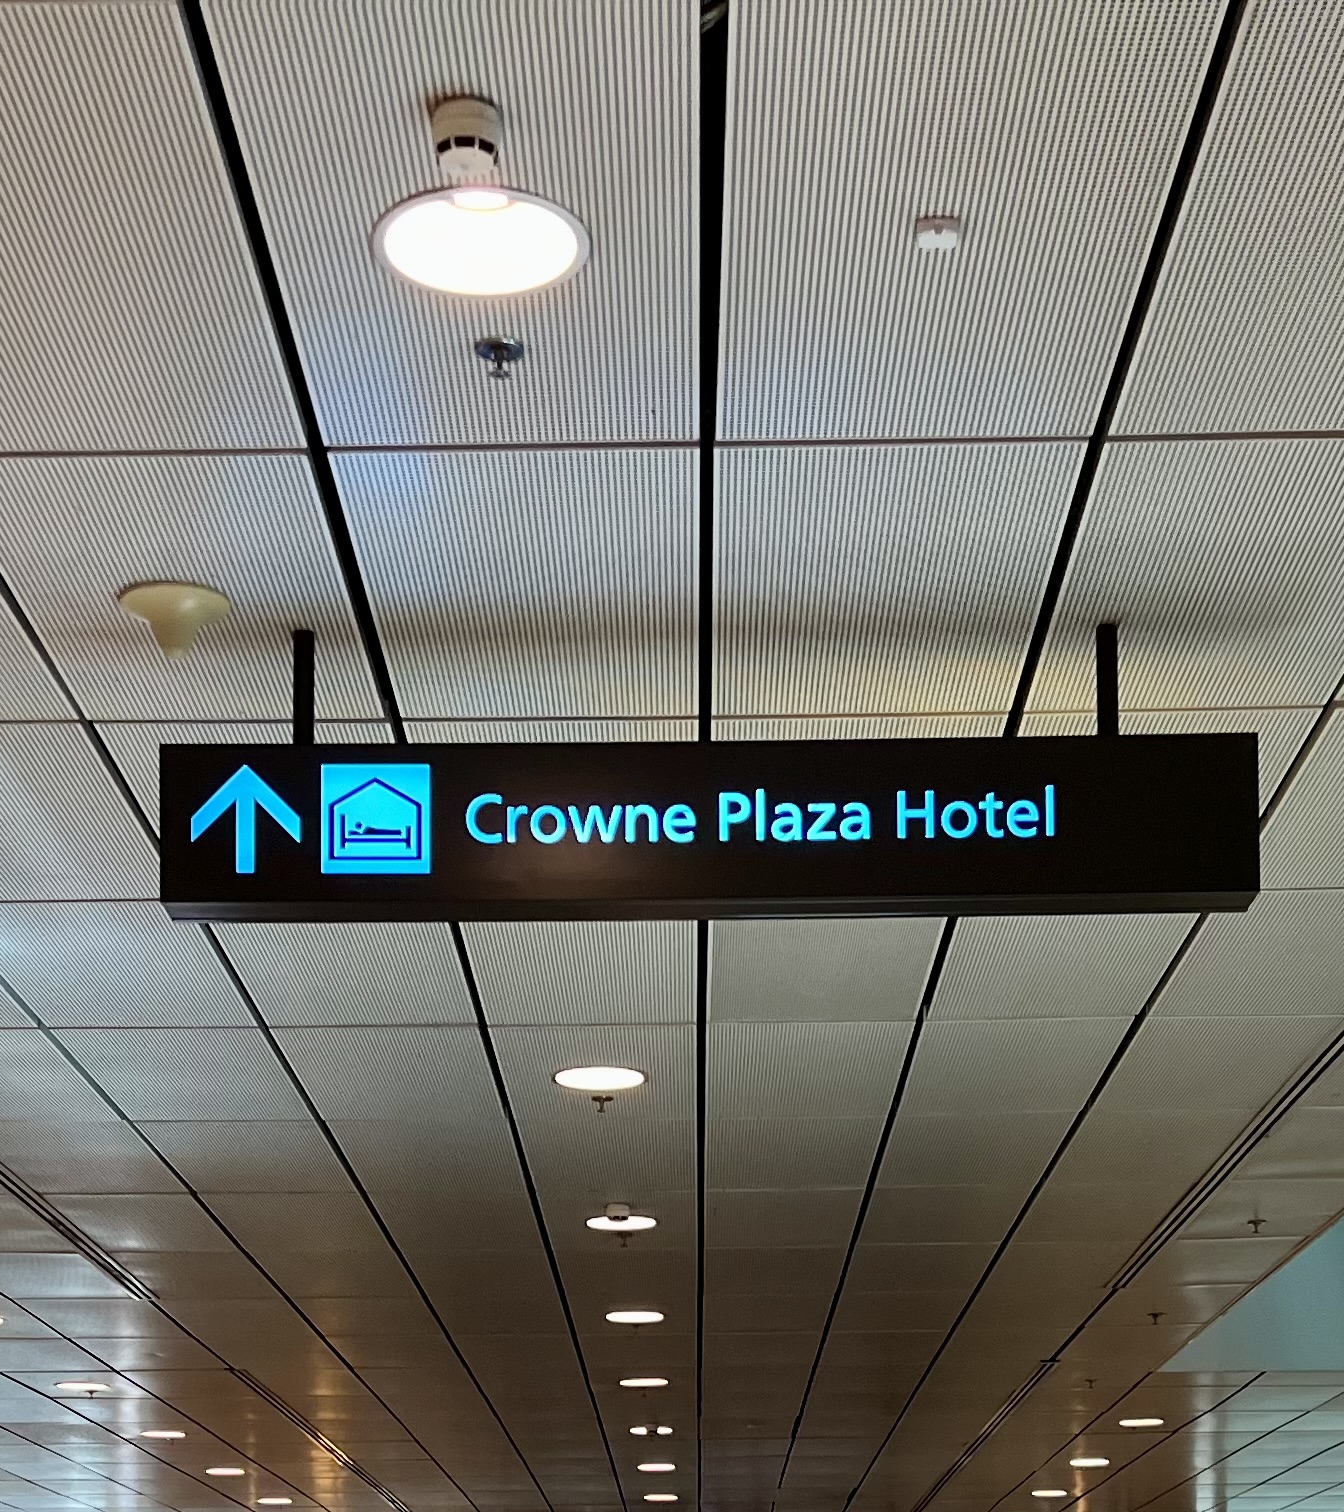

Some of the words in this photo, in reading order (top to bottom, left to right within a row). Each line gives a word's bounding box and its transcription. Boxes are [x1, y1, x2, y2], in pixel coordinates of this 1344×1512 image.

[464, 792, 698, 845] Crowne
[717, 788, 872, 843] Plaza
[895, 784, 1056, 839] Hotel
